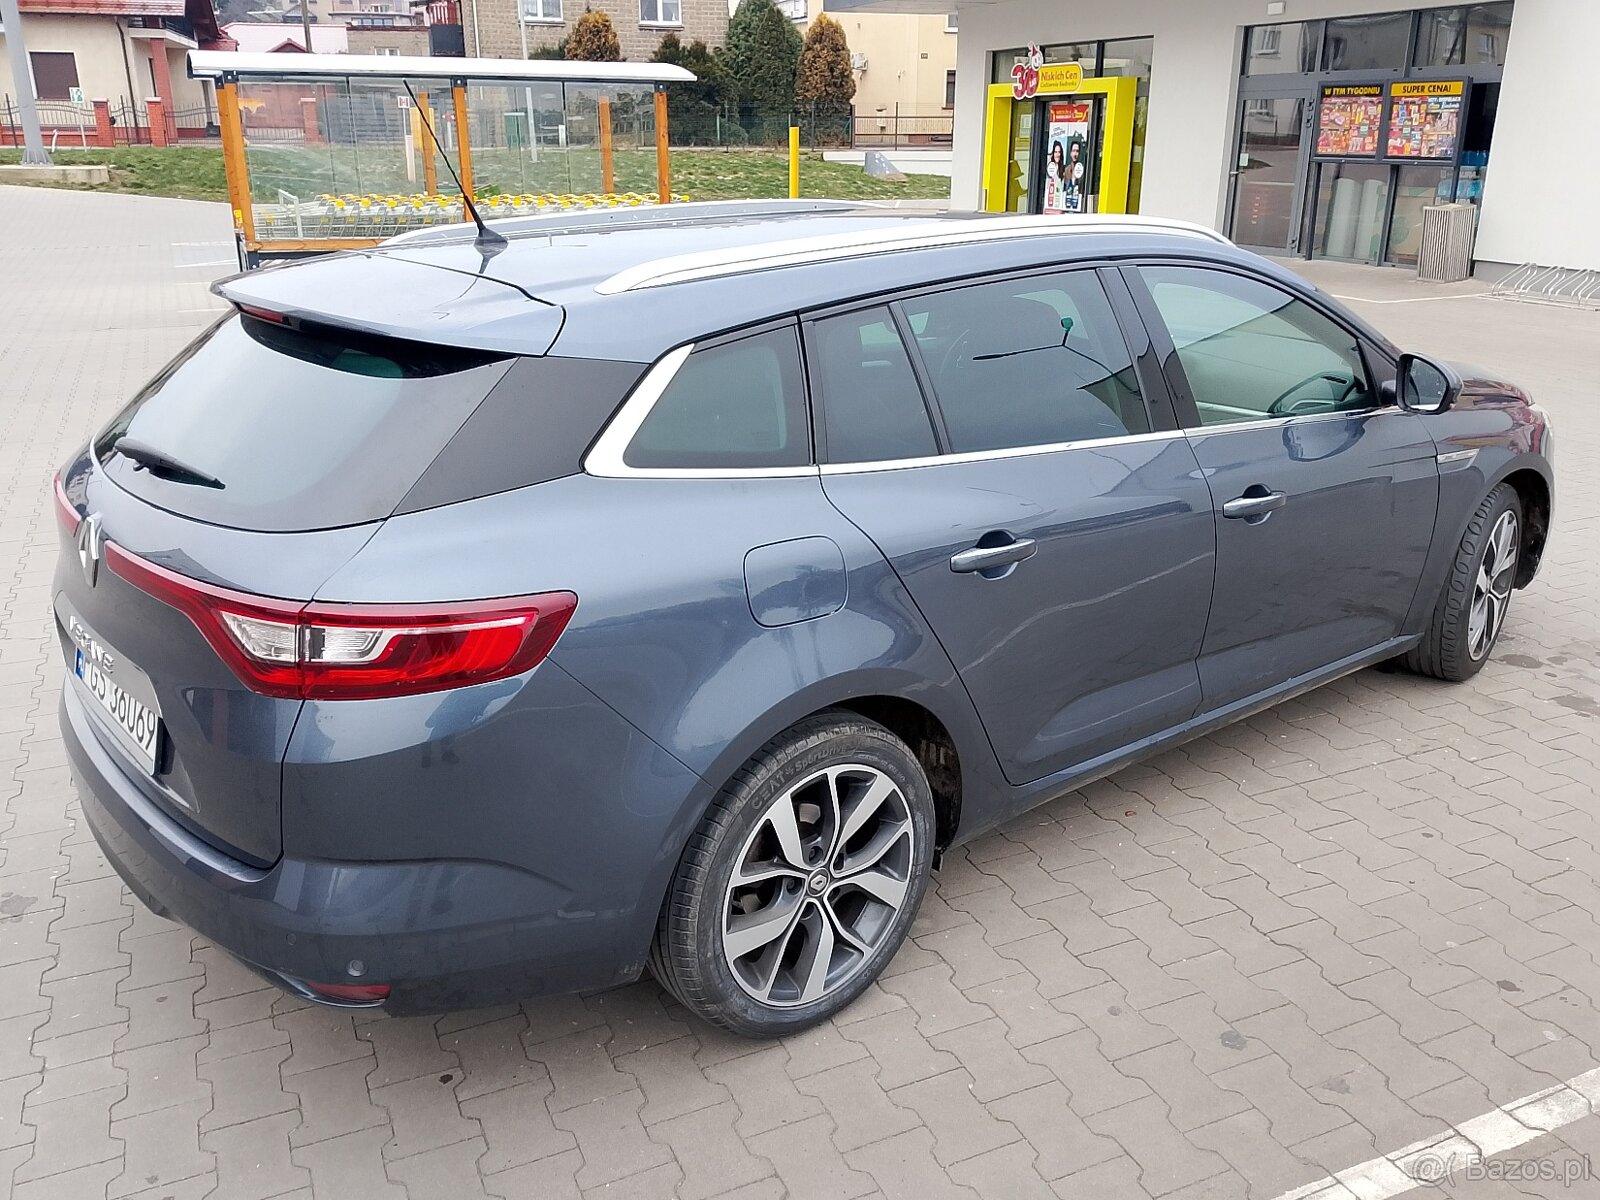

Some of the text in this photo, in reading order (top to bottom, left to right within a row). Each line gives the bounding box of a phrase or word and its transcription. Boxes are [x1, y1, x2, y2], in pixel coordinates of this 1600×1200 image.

[1041, 70, 1078, 81] Niskich Cen
[1324, 86, 1381, 95] W TYM TYGODNIU
[1402, 84, 1452, 94] SUPER CENA!
